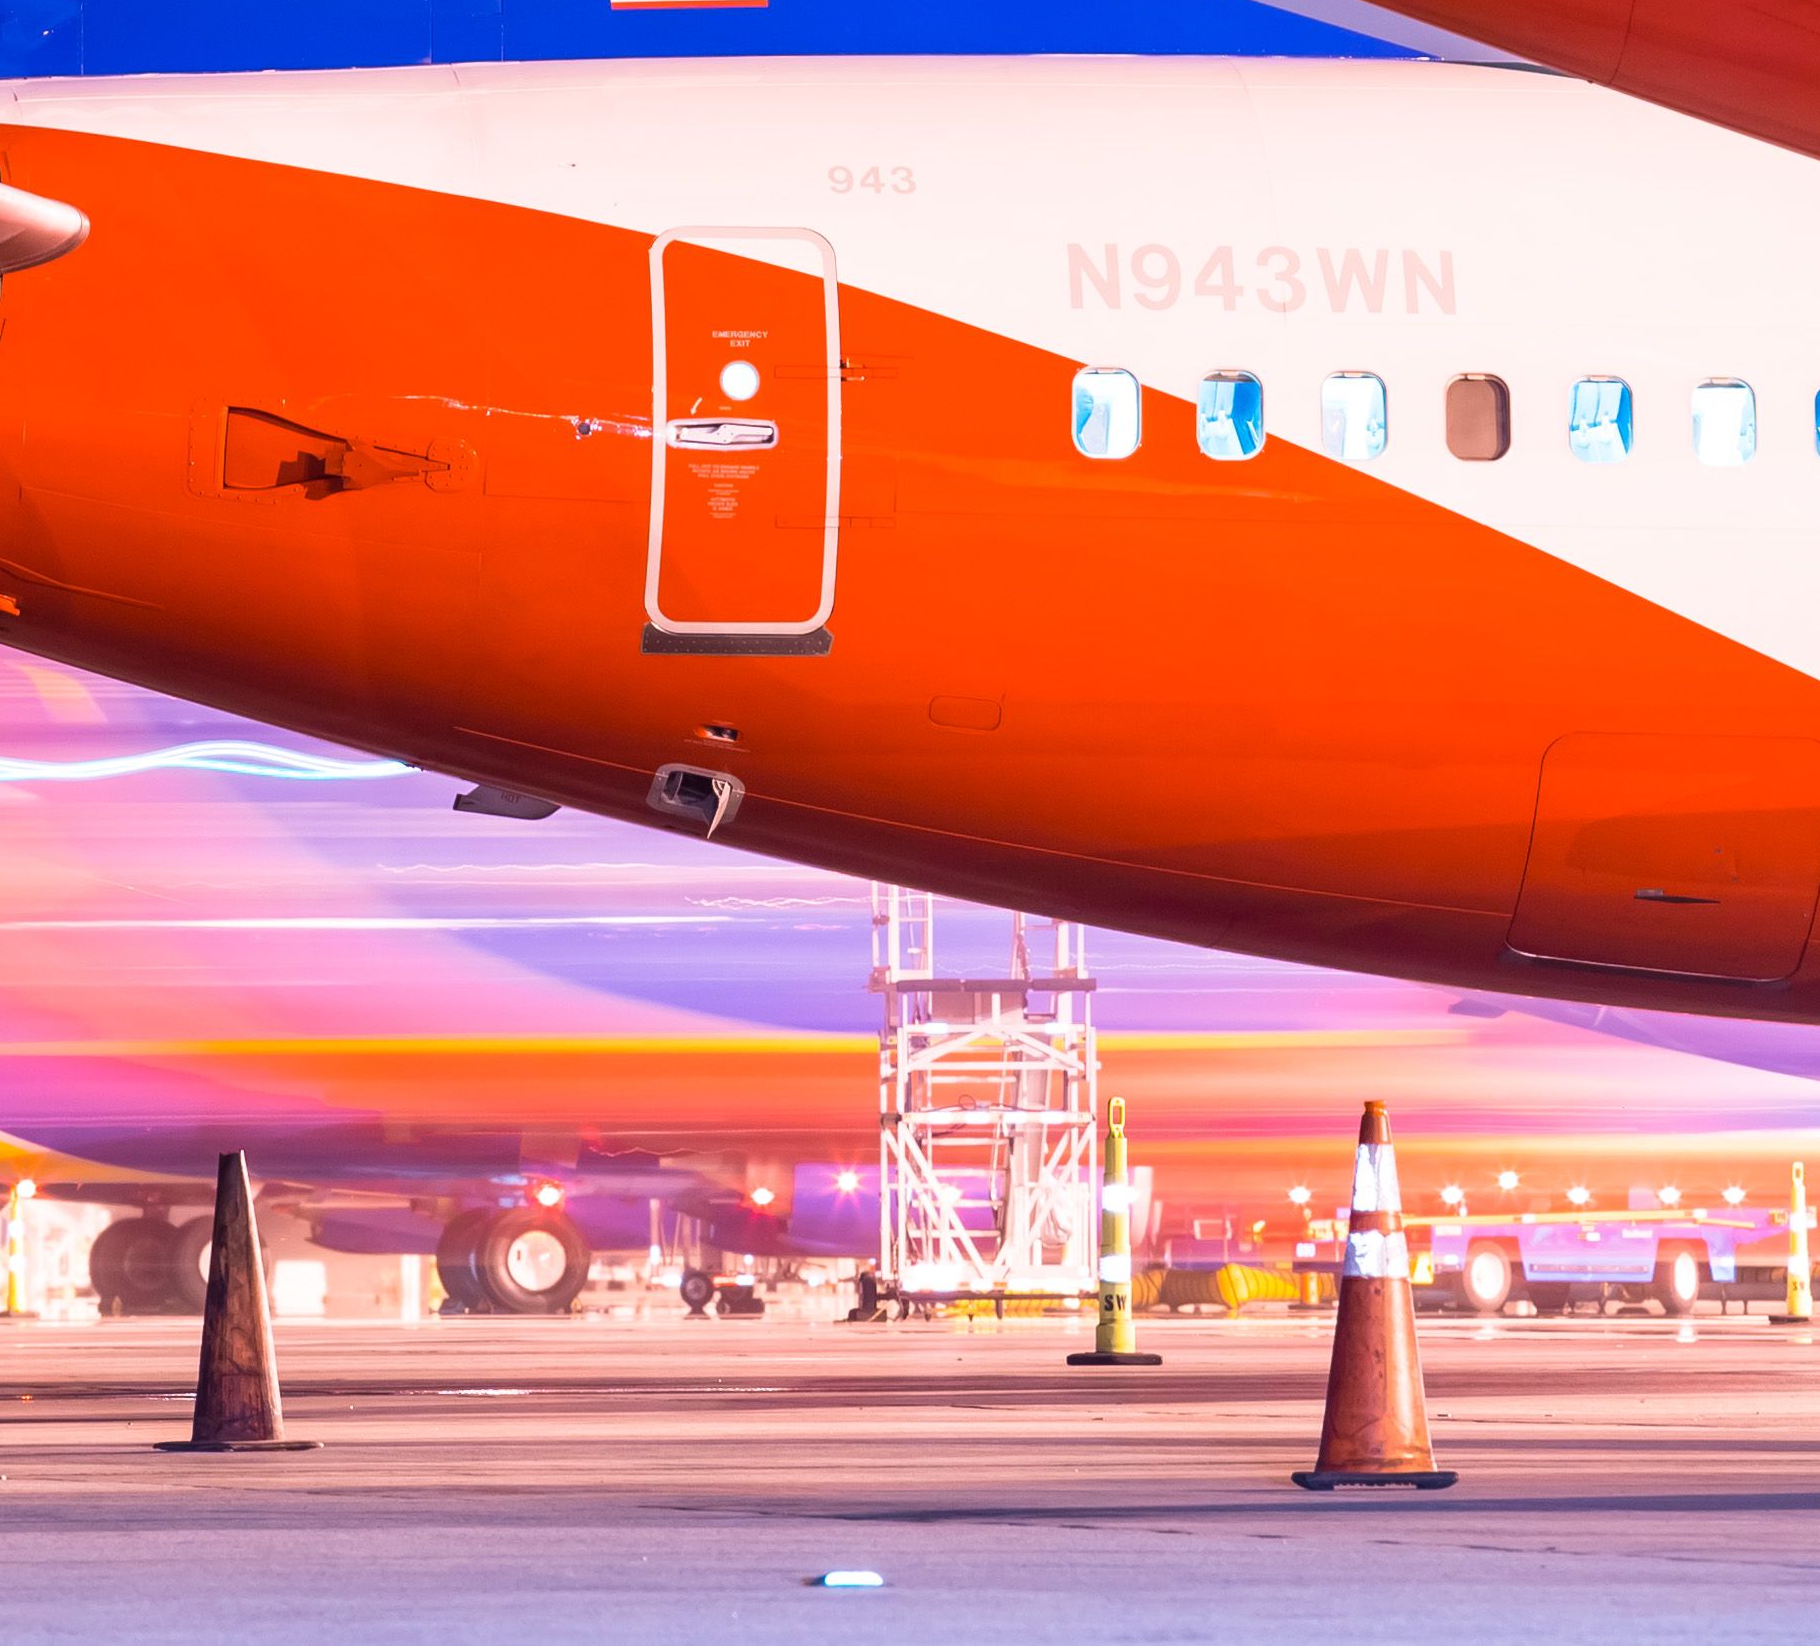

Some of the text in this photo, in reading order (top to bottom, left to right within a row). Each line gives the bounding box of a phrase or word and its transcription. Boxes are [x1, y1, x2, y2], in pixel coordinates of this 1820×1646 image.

[827, 165, 917, 194] 943
[1067, 242, 1457, 316] N943WN
[712, 330, 769, 339] EMERGENCY
[729, 339, 751, 347] EXIT
[1104, 1294, 1127, 1312] SW
